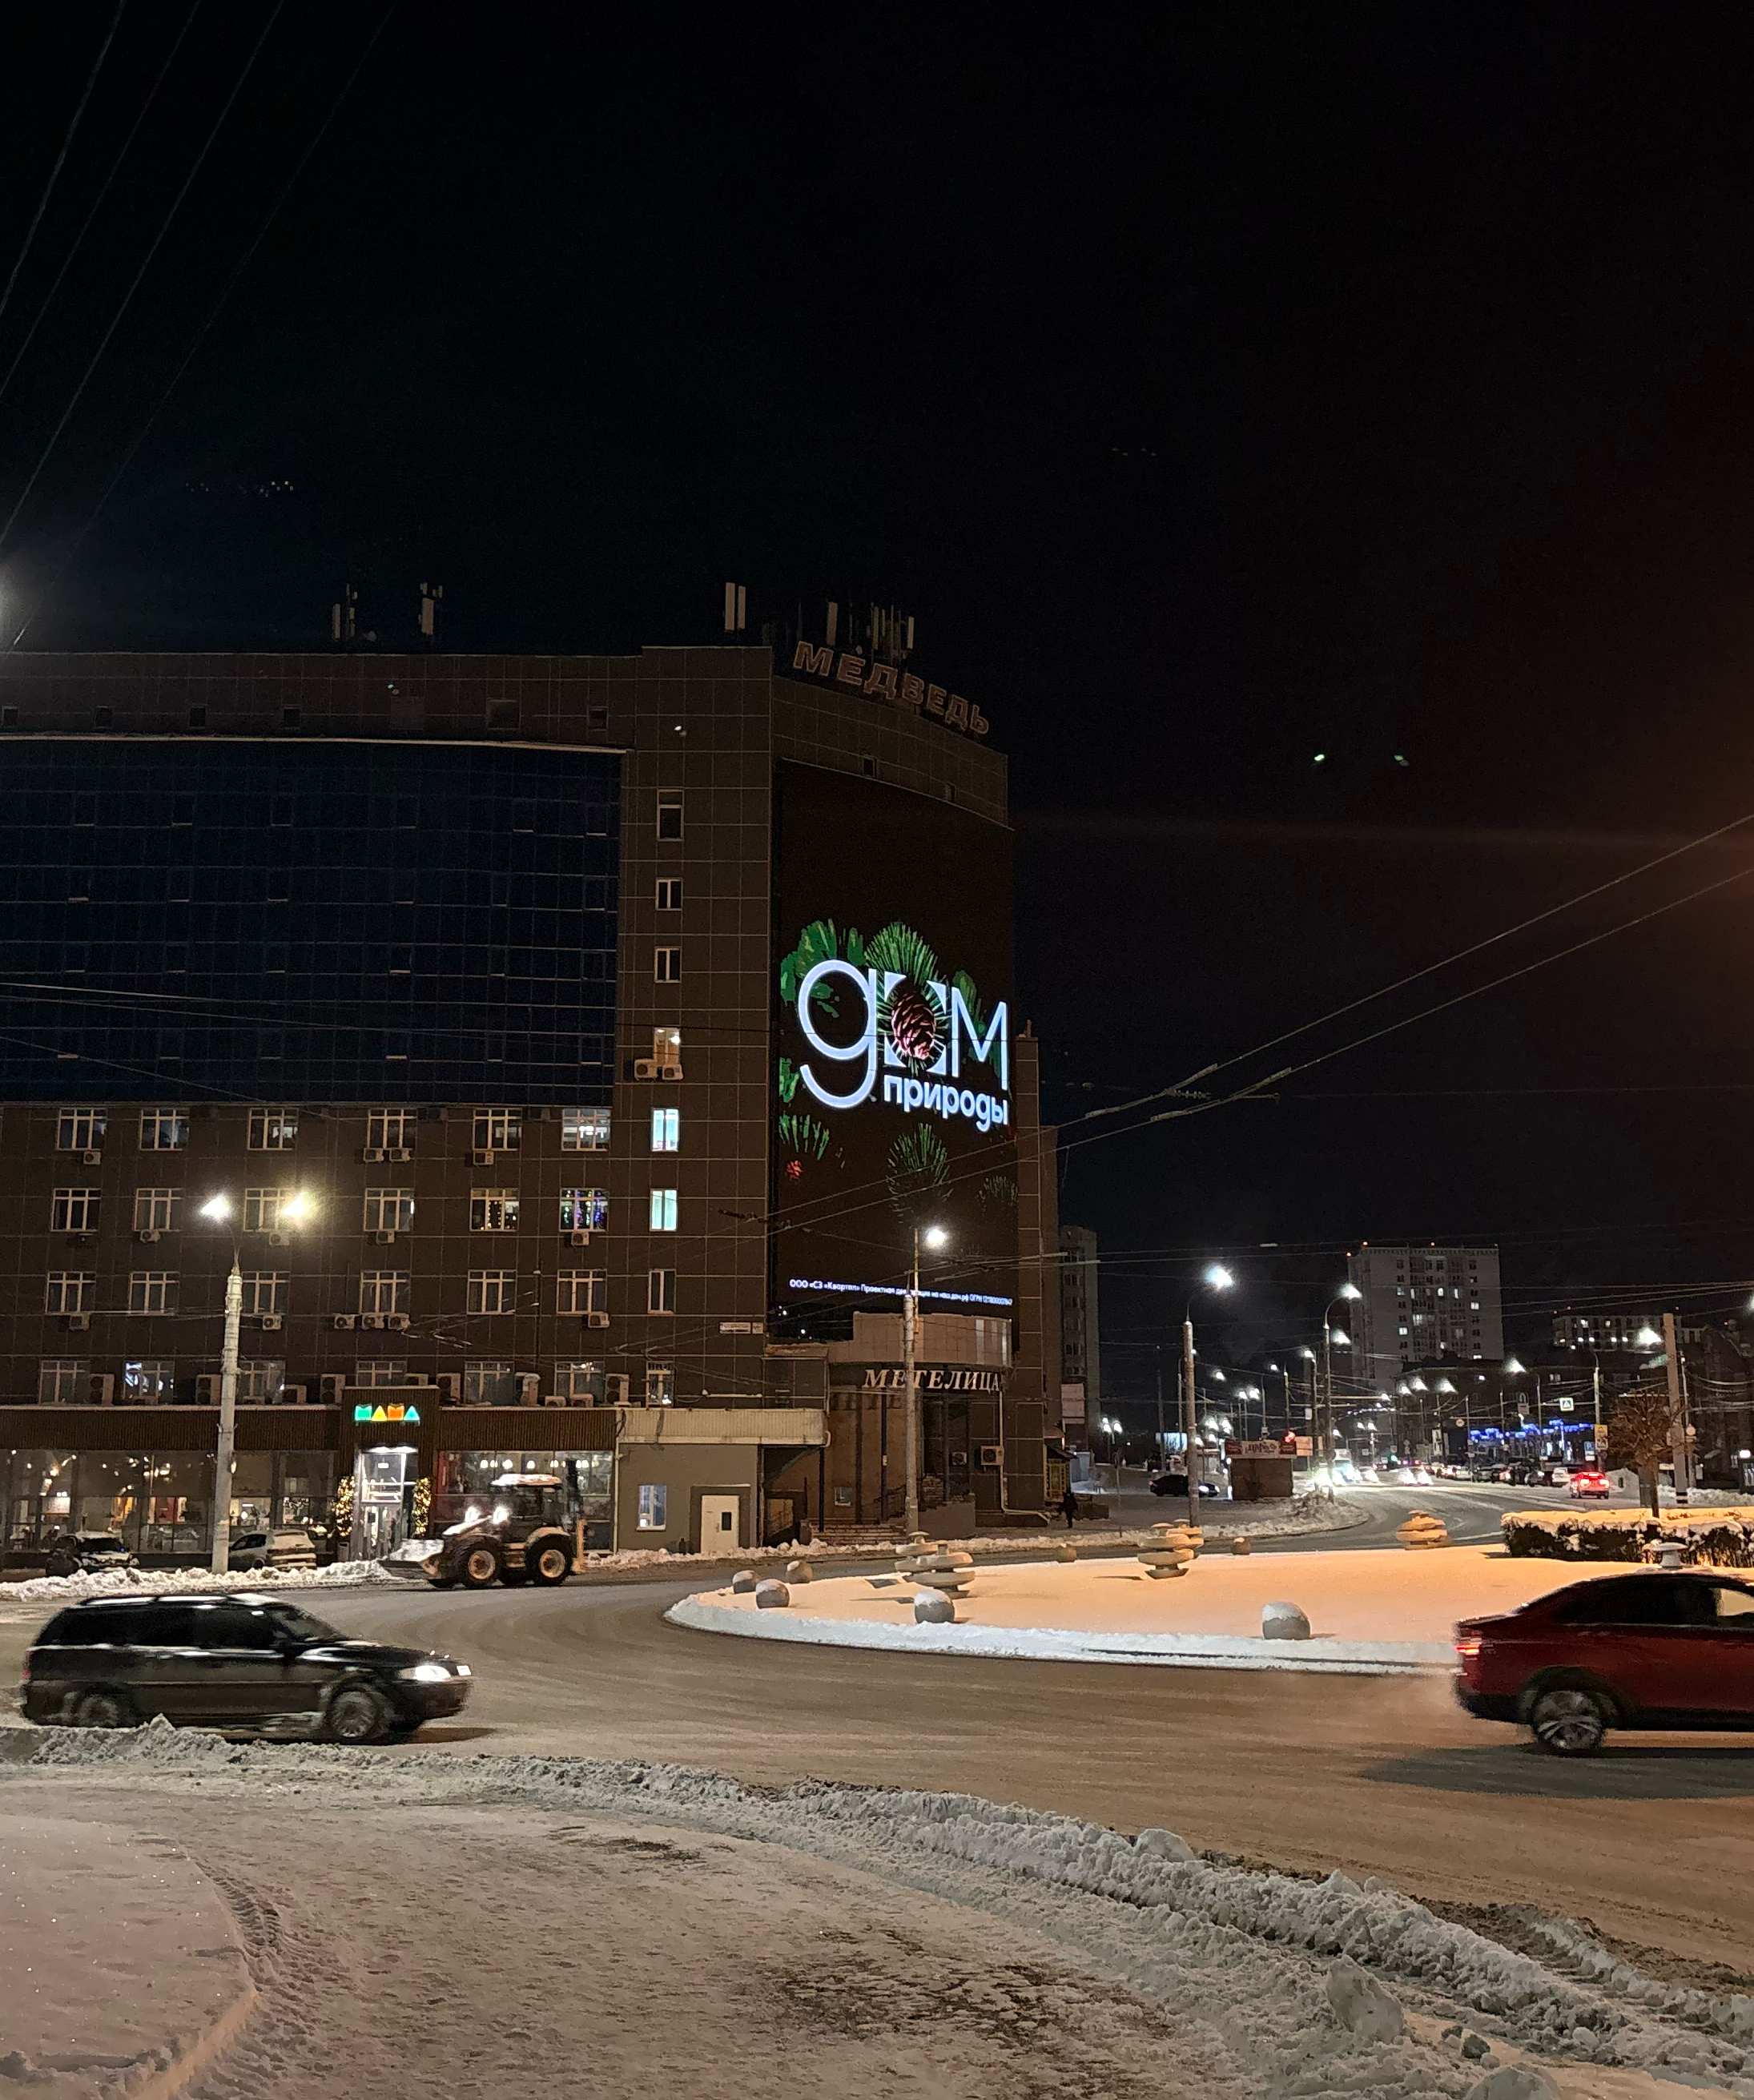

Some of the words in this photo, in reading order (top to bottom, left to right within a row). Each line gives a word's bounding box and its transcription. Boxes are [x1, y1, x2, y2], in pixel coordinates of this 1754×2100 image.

[793, 640, 989, 734] МЕДВЕДЬ
[883, 1074, 1008, 1132] природы
[789, 1279, 808, 1288] ООО
[862, 1369, 1000, 1394] МЕТЕЛИЦА
